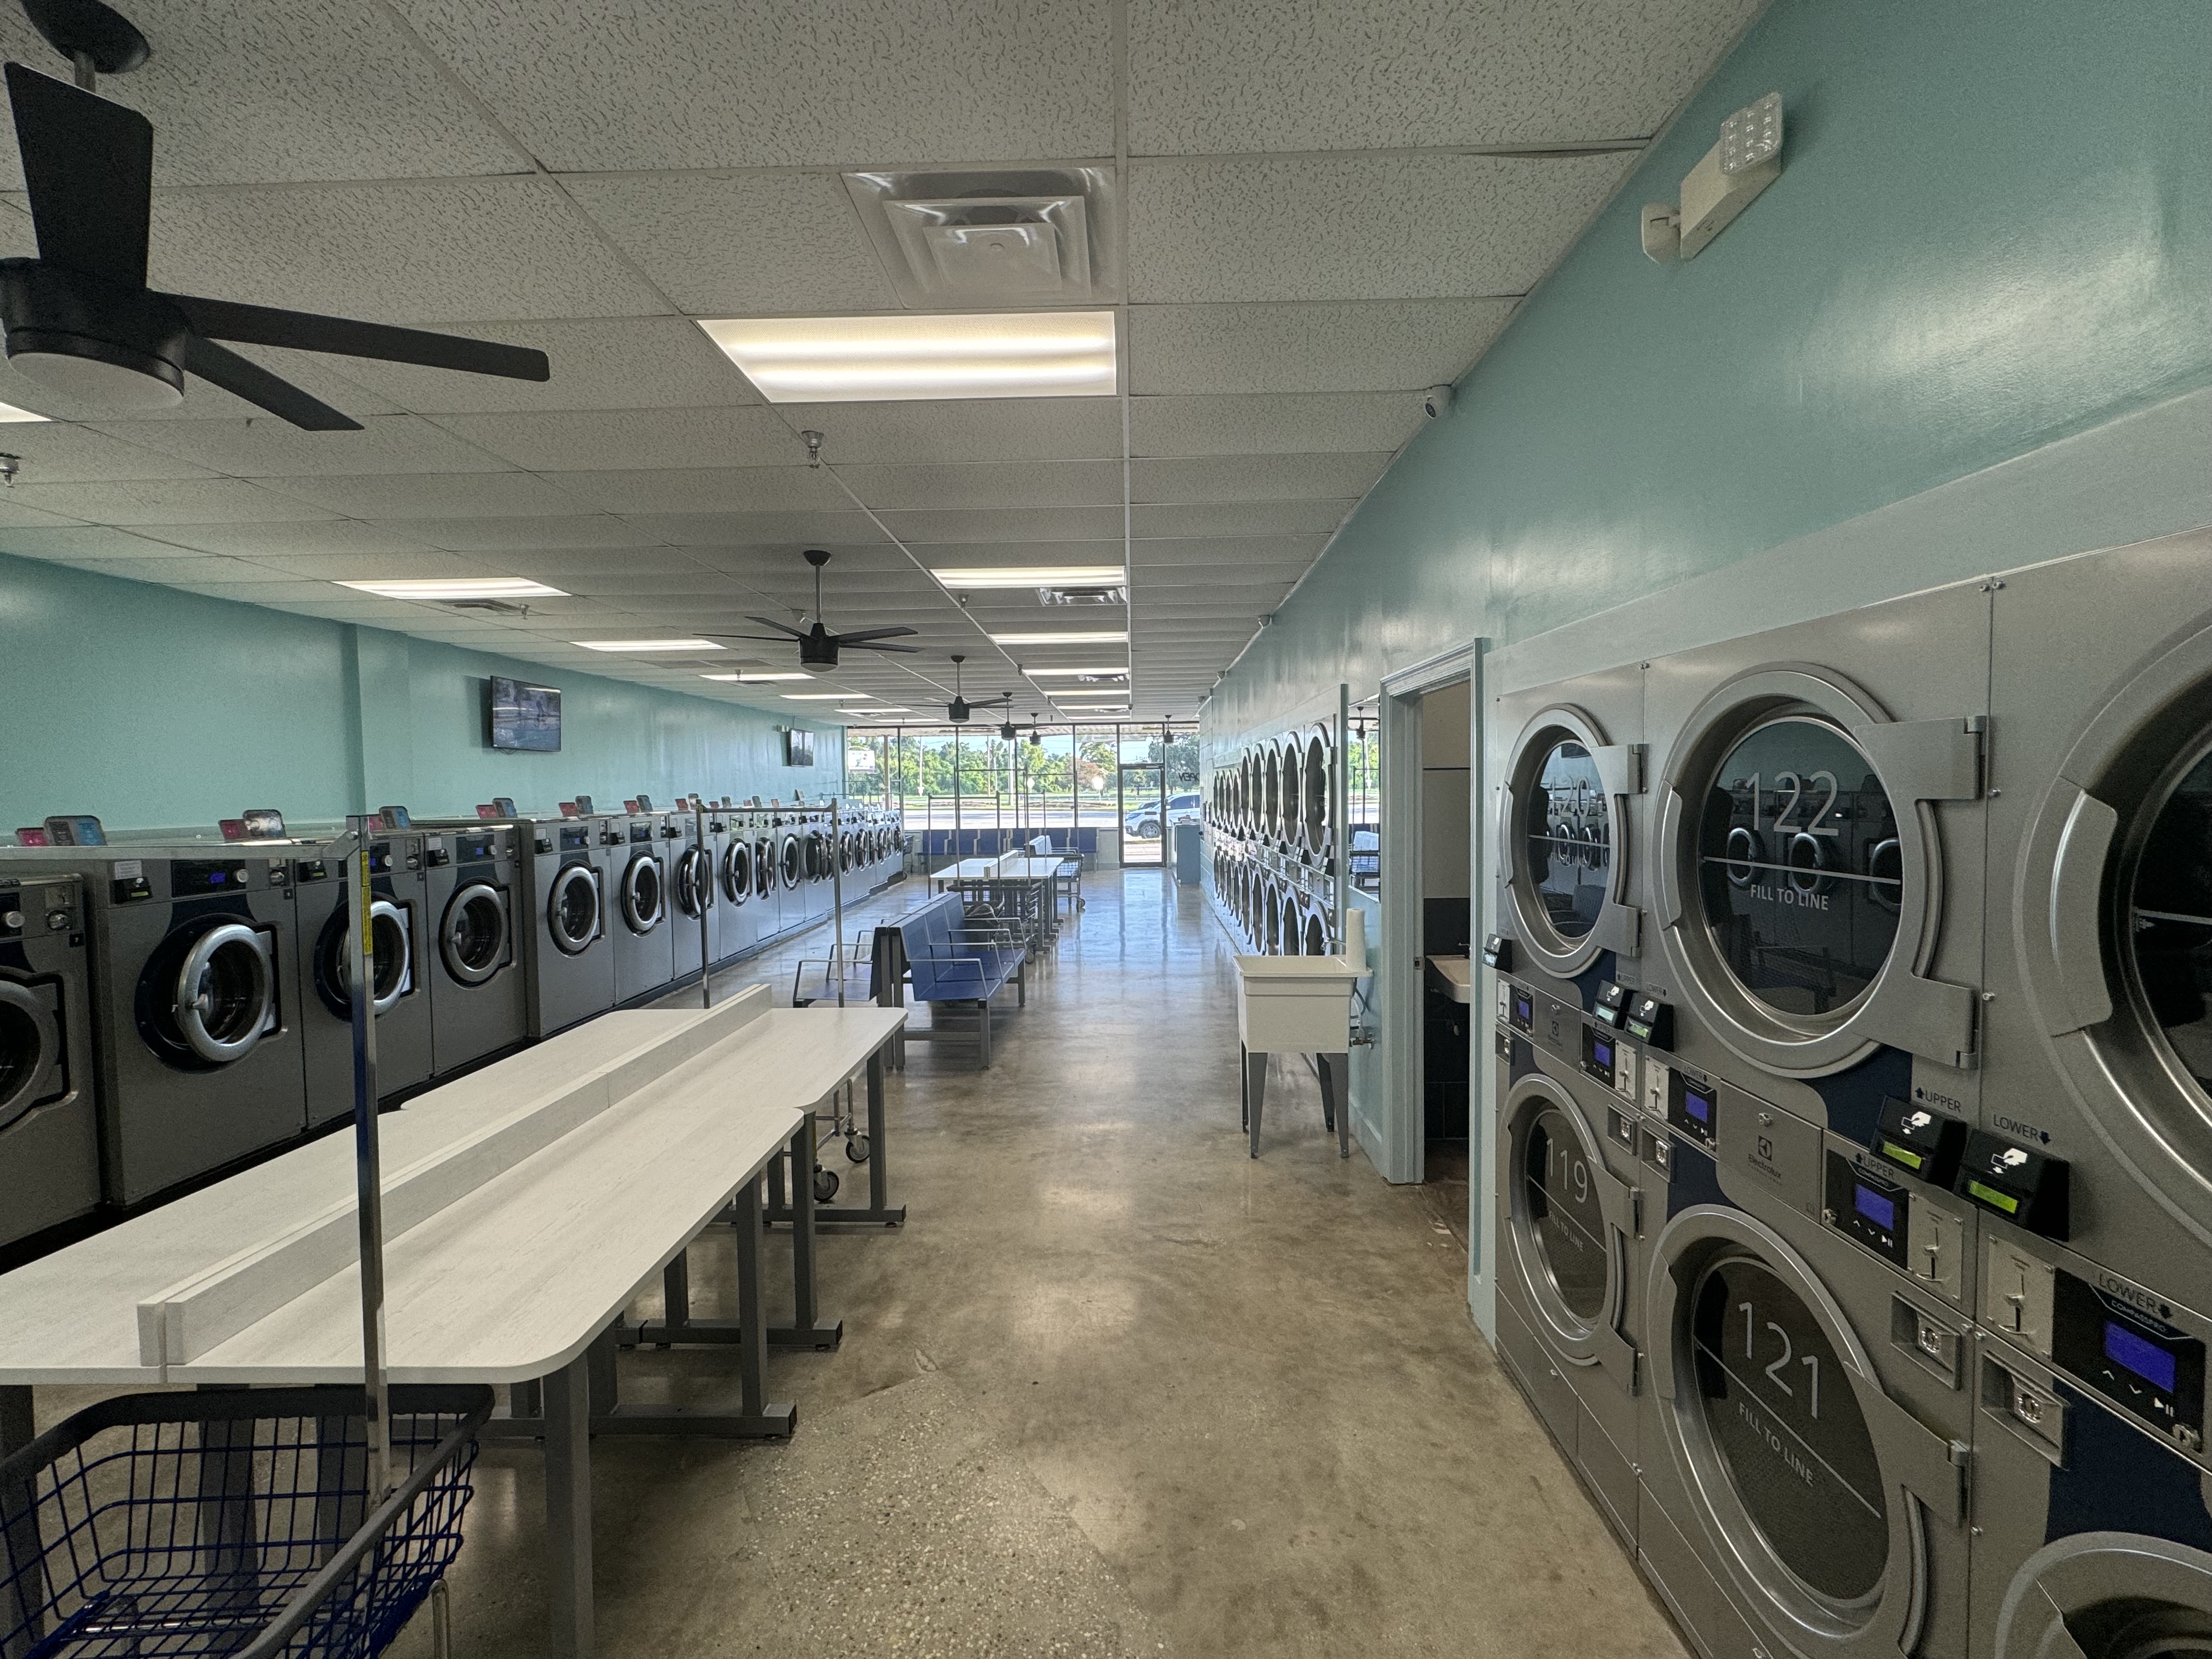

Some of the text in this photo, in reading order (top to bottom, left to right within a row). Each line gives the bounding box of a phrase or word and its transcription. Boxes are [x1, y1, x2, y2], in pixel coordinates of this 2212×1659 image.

[1746, 770, 1838, 836] 122
[1751, 884, 1829, 911] FILL TO LINE
[1925, 1090, 1962, 1113] UPPER
[1993, 1114, 2039, 1142] LOWER
[1546, 1138, 1588, 1204] 119
[1863, 1155, 1895, 1181] UPPER
[1549, 1210, 1585, 1252] FILL TO LINE
[2099, 1273, 2157, 1313] LOWER
[1739, 1302, 1819, 1420] 121
[1739, 1402, 1814, 1487] FILL TO LINE
